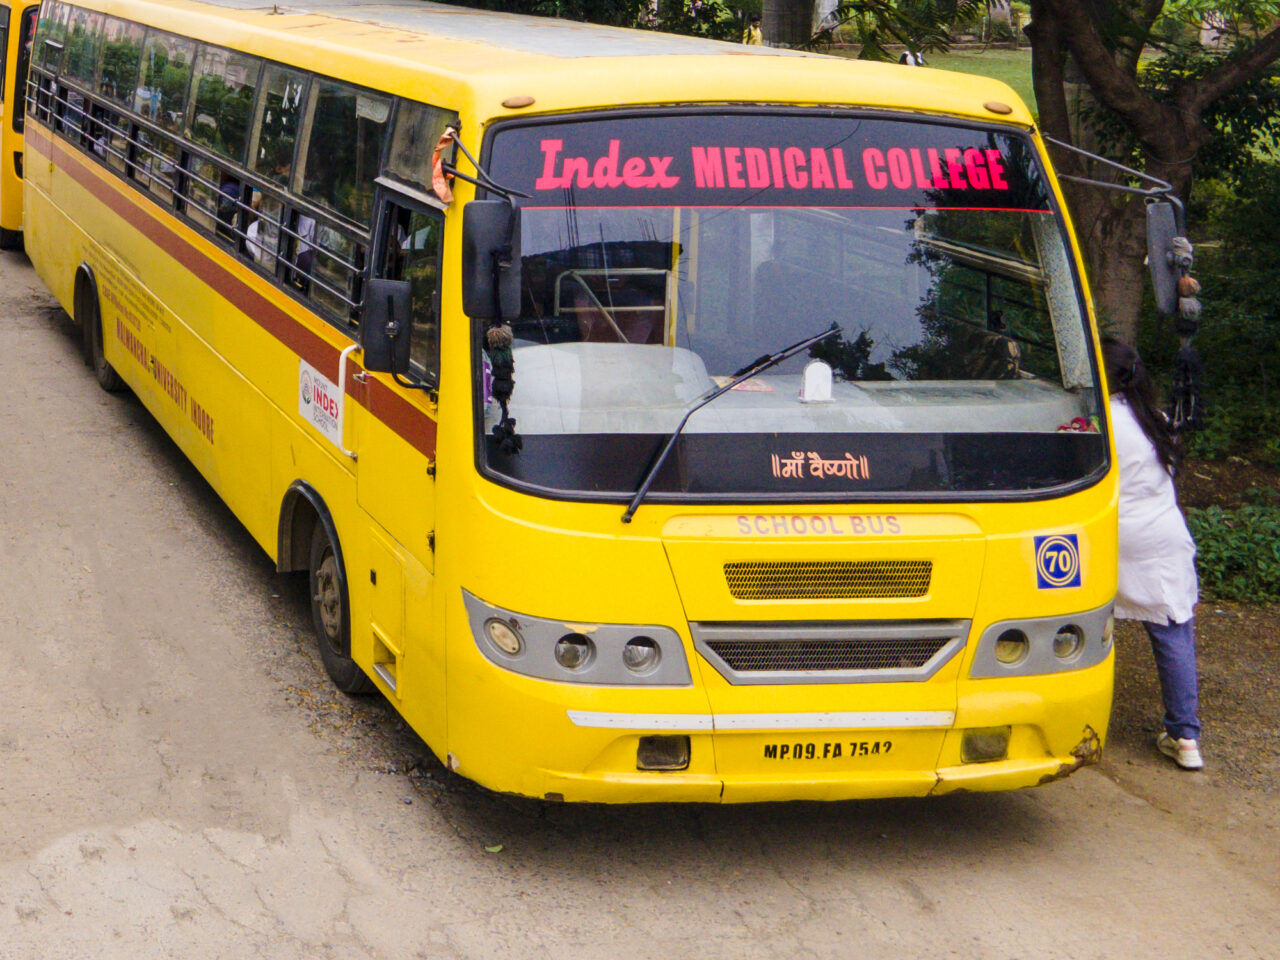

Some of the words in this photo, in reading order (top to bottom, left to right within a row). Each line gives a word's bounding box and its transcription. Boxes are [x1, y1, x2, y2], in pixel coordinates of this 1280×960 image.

[535, 139, 680, 190] Index
[691, 146, 853, 190] MEDICAL
[862, 147, 1009, 191] COLLEGE
[151, 355, 187, 417] UNIVERSITY
[190, 395, 215, 446] INDORE
[736, 515, 844, 535] SCHOOL
[849, 515, 902, 535] BUS
[1045, 550, 1071, 572] 70
[849, 741, 893, 757] 7542
